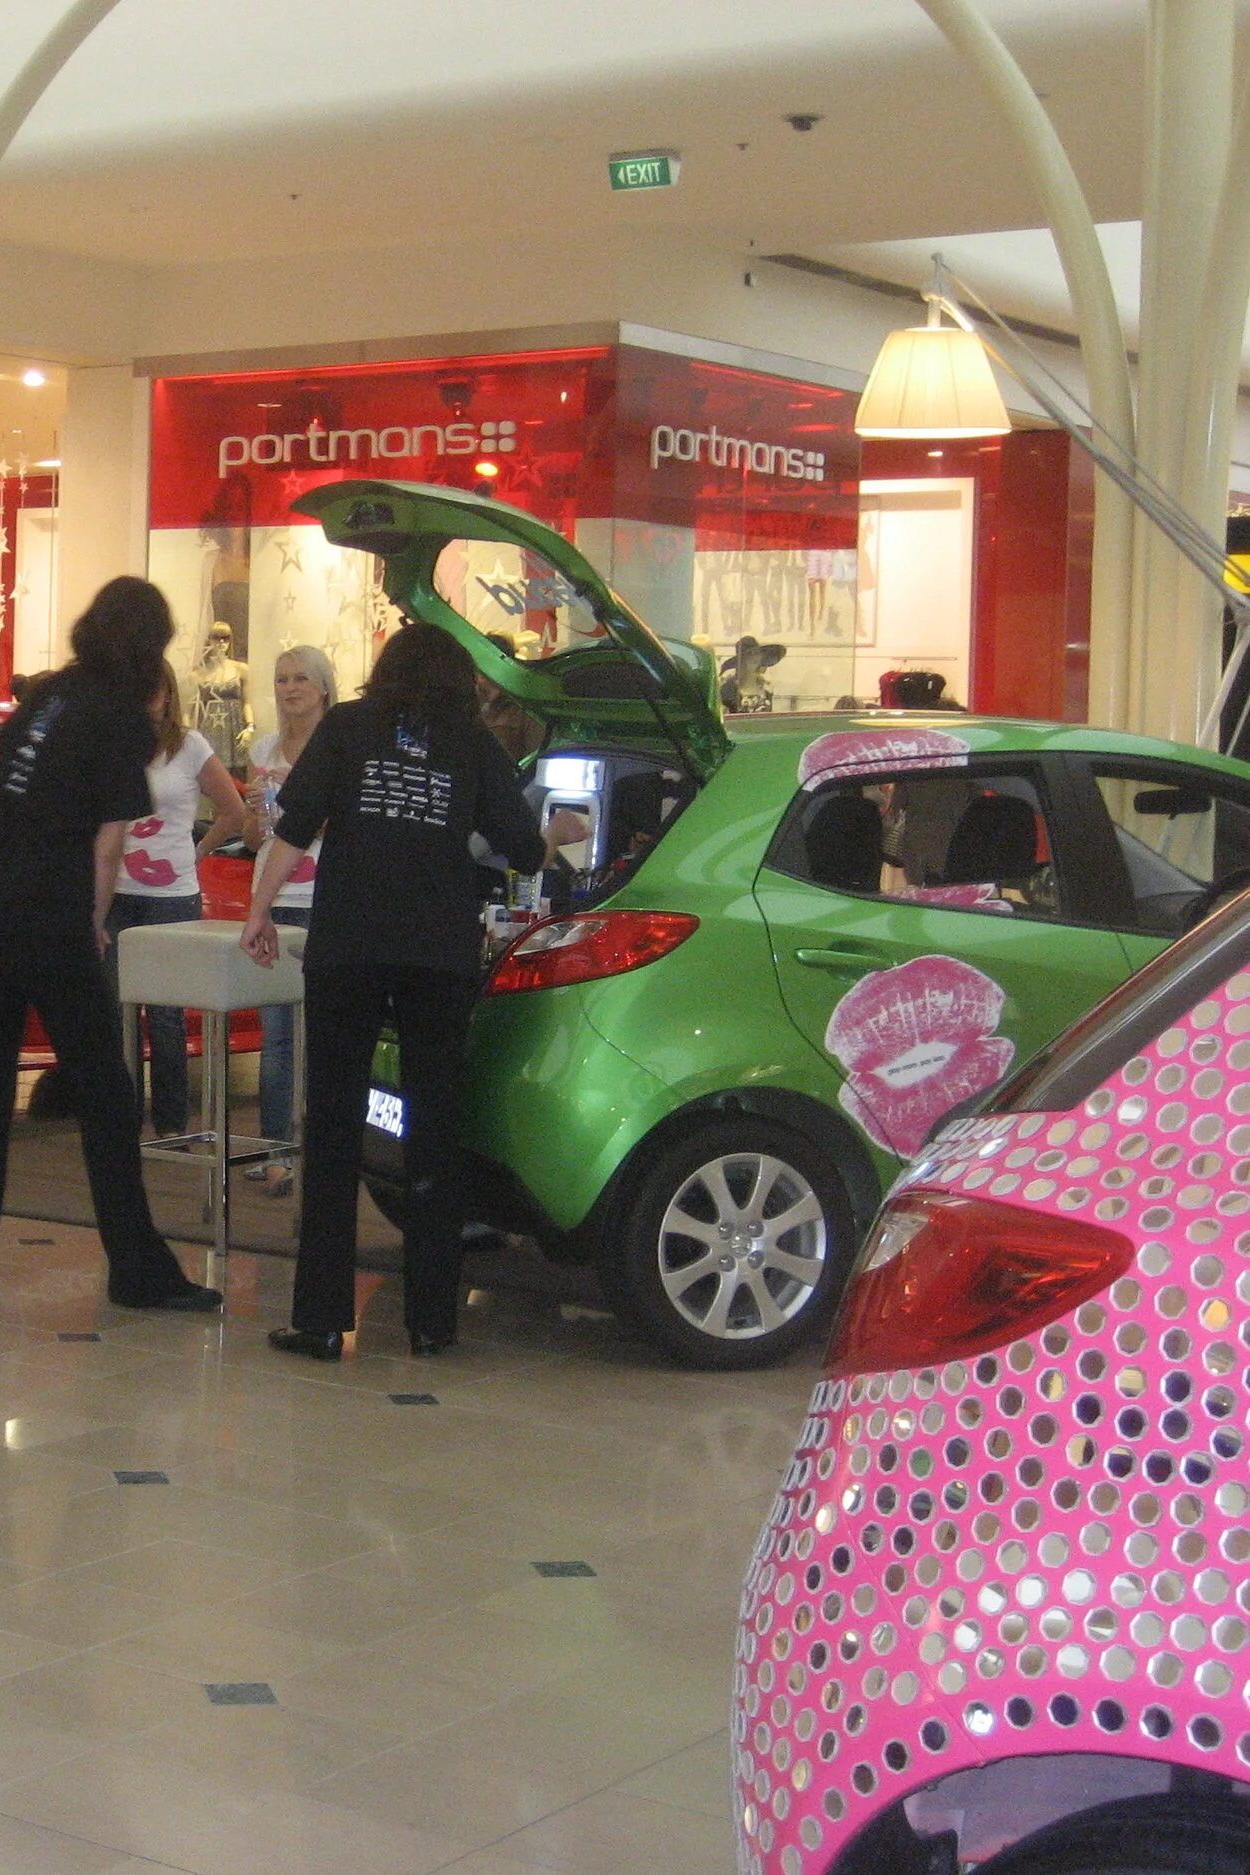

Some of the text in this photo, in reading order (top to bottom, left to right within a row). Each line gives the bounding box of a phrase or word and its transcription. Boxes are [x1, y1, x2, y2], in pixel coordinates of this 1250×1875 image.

[626, 162, 660, 185] EXIT
[218, 422, 479, 478] portmans
[653, 424, 804, 479] portmans
